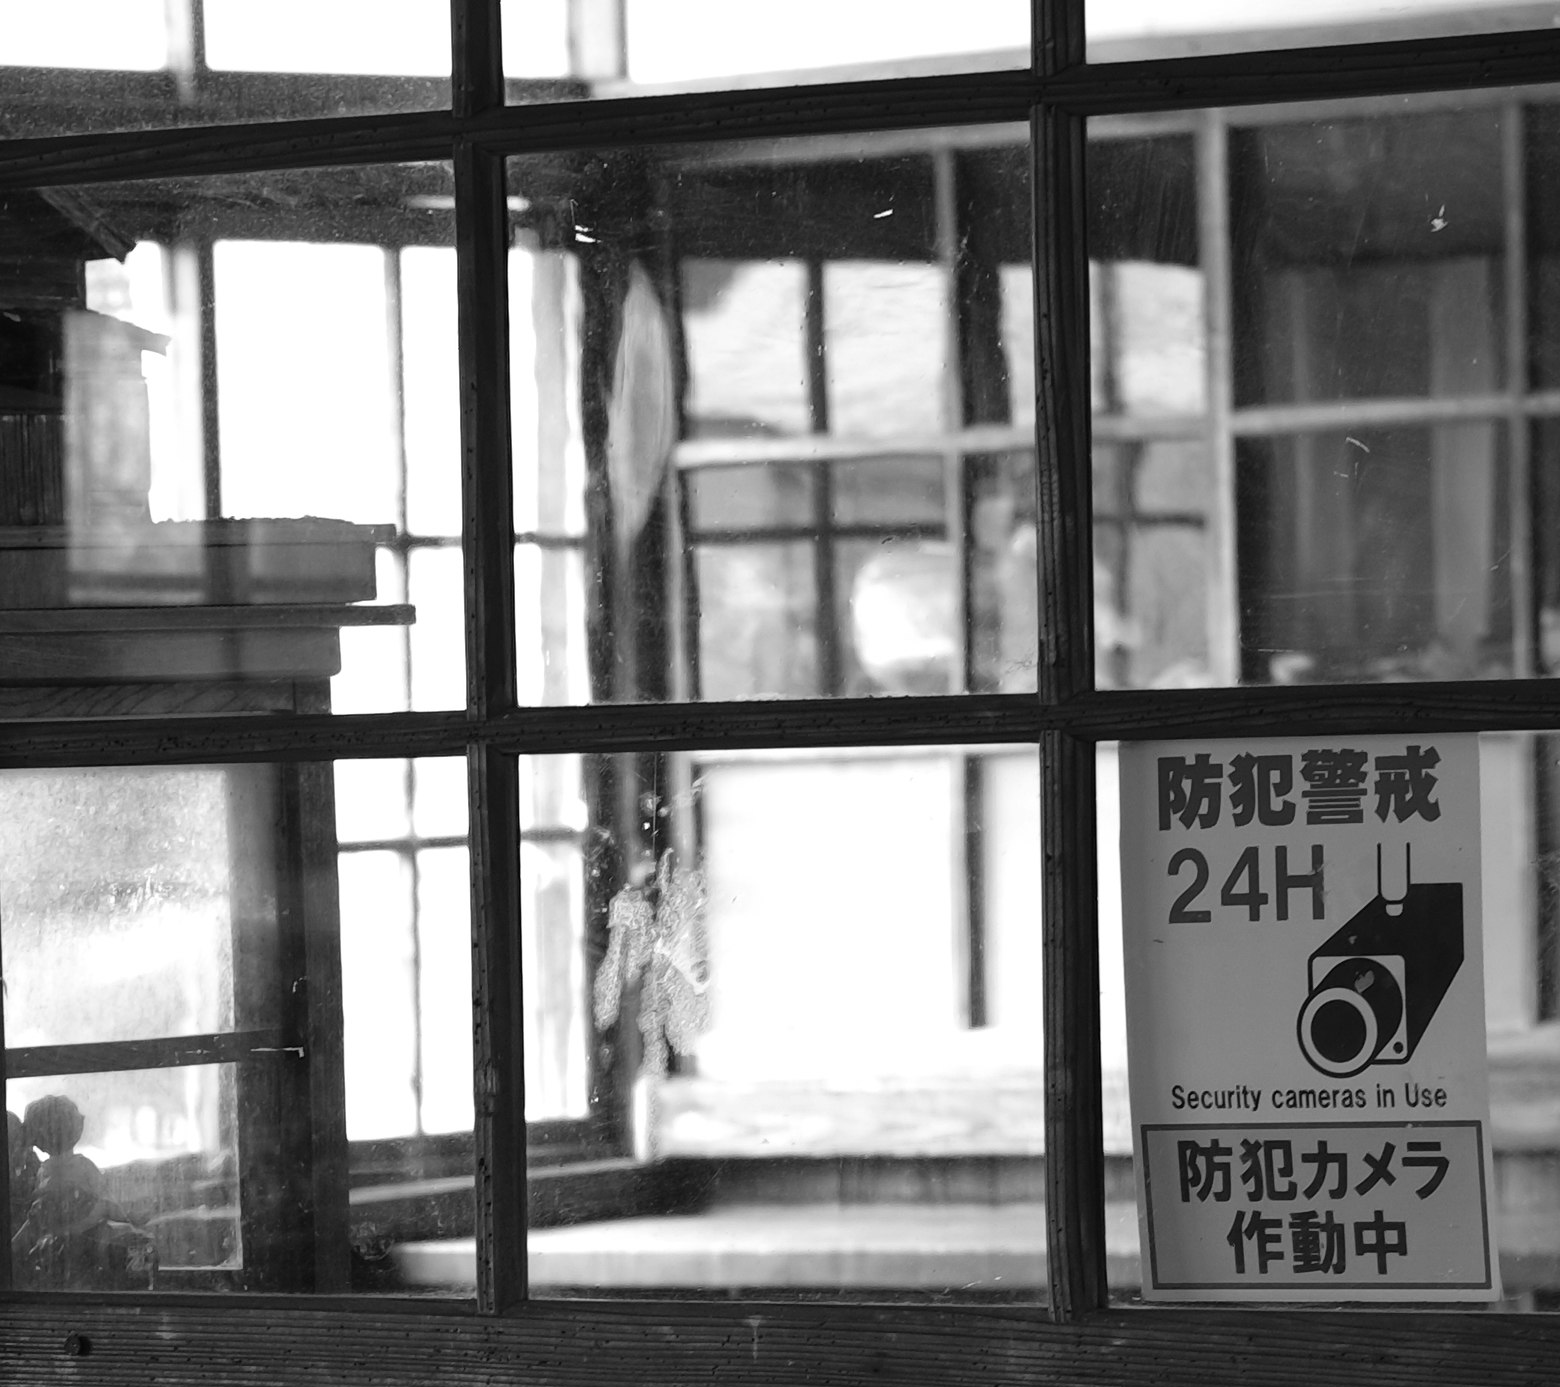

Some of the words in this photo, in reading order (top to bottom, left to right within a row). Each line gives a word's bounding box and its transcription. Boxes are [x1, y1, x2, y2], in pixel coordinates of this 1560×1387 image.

[1157, 745, 1442, 832] 防犯警戒
[1167, 843, 1326, 924] 24H
[1171, 1083, 1262, 1113] Security
[1272, 1085, 1367, 1110] cameras
[1376, 1082, 1396, 1109] in
[1405, 1082, 1448, 1109] Use
[1177, 1138, 1451, 1204] 防犯カメラ
[1227, 1209, 1409, 1275] 作動中
